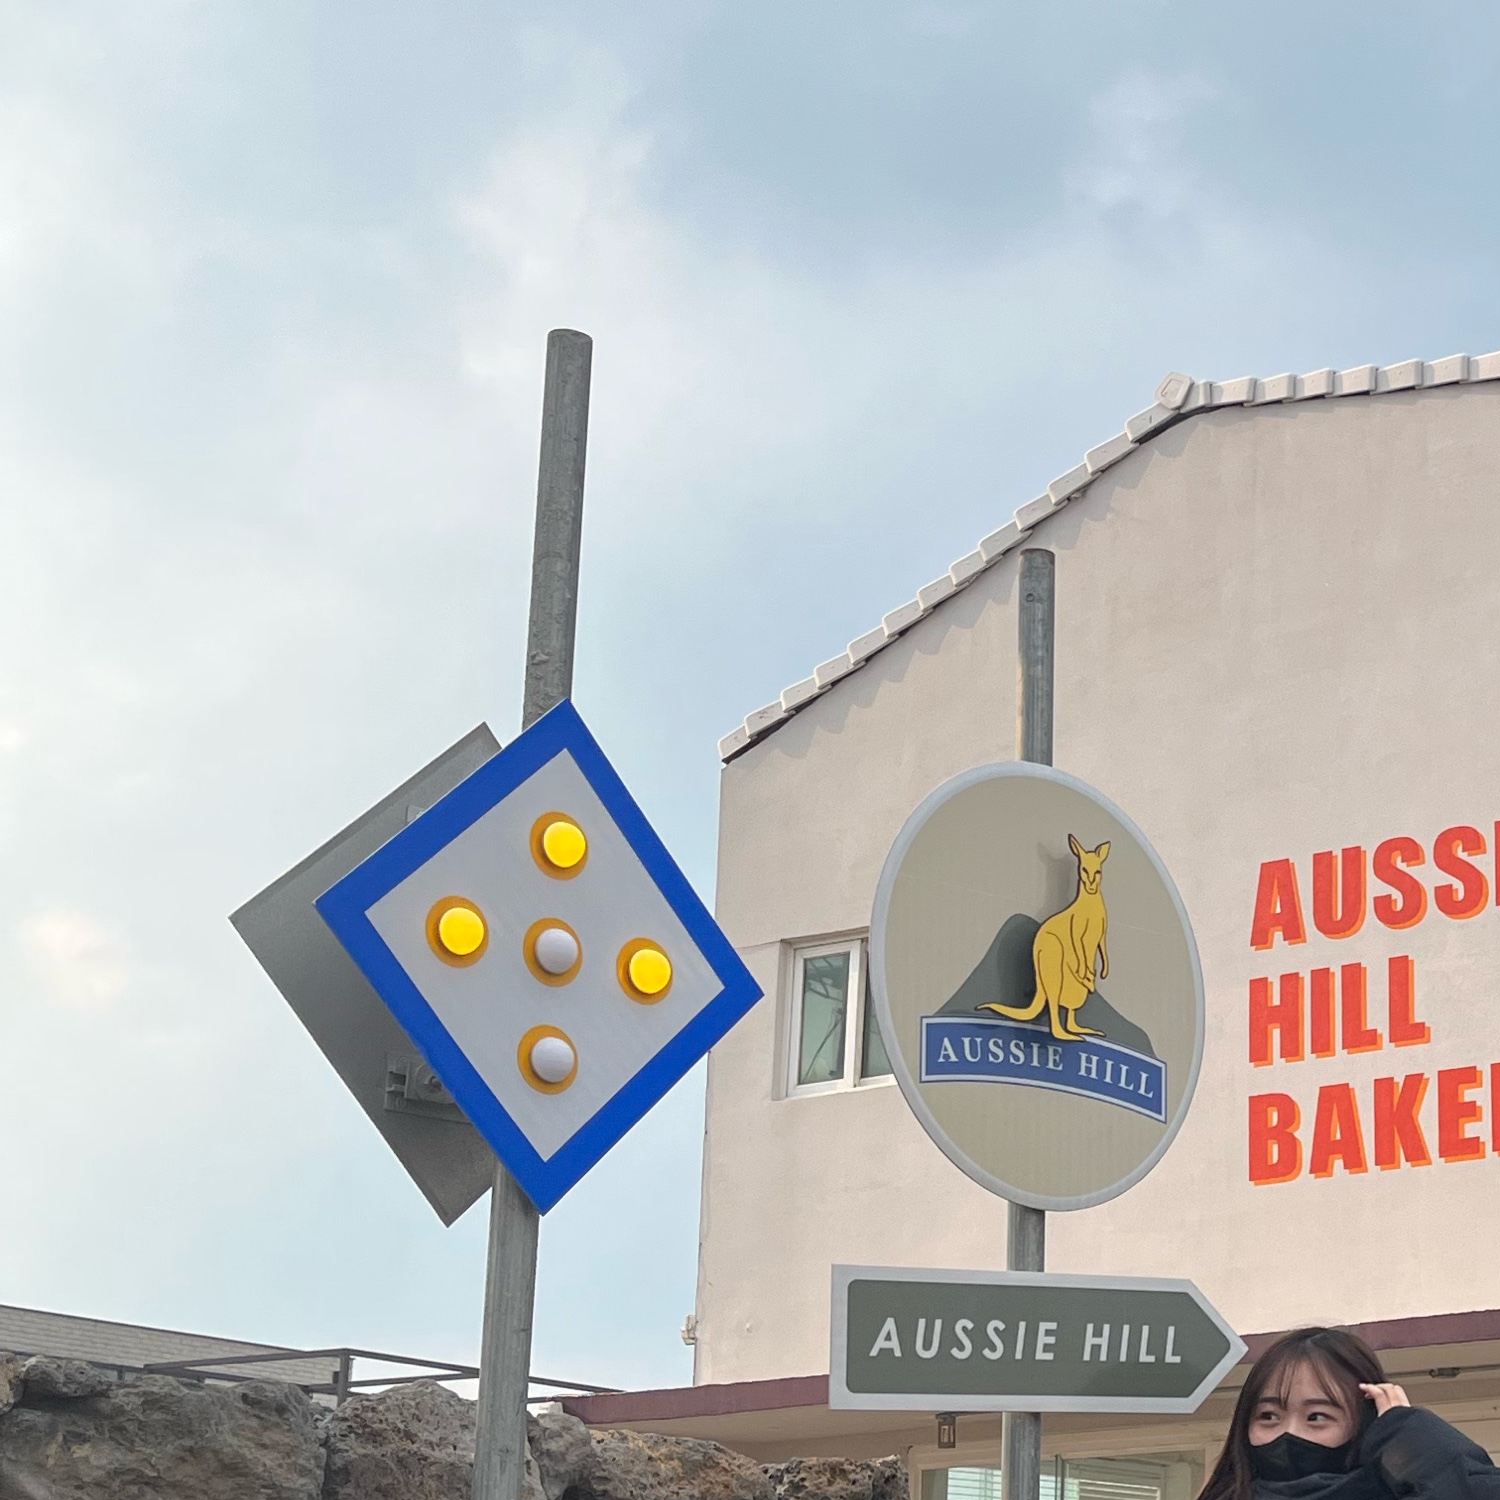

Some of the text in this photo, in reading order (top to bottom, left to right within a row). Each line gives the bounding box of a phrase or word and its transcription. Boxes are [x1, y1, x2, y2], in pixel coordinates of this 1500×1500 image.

[1249, 955, 1431, 1067] HILL
[937, 1037, 1154, 1098] AUSSIE HILL
[869, 1317, 1181, 1363] AUSSIE HILL
